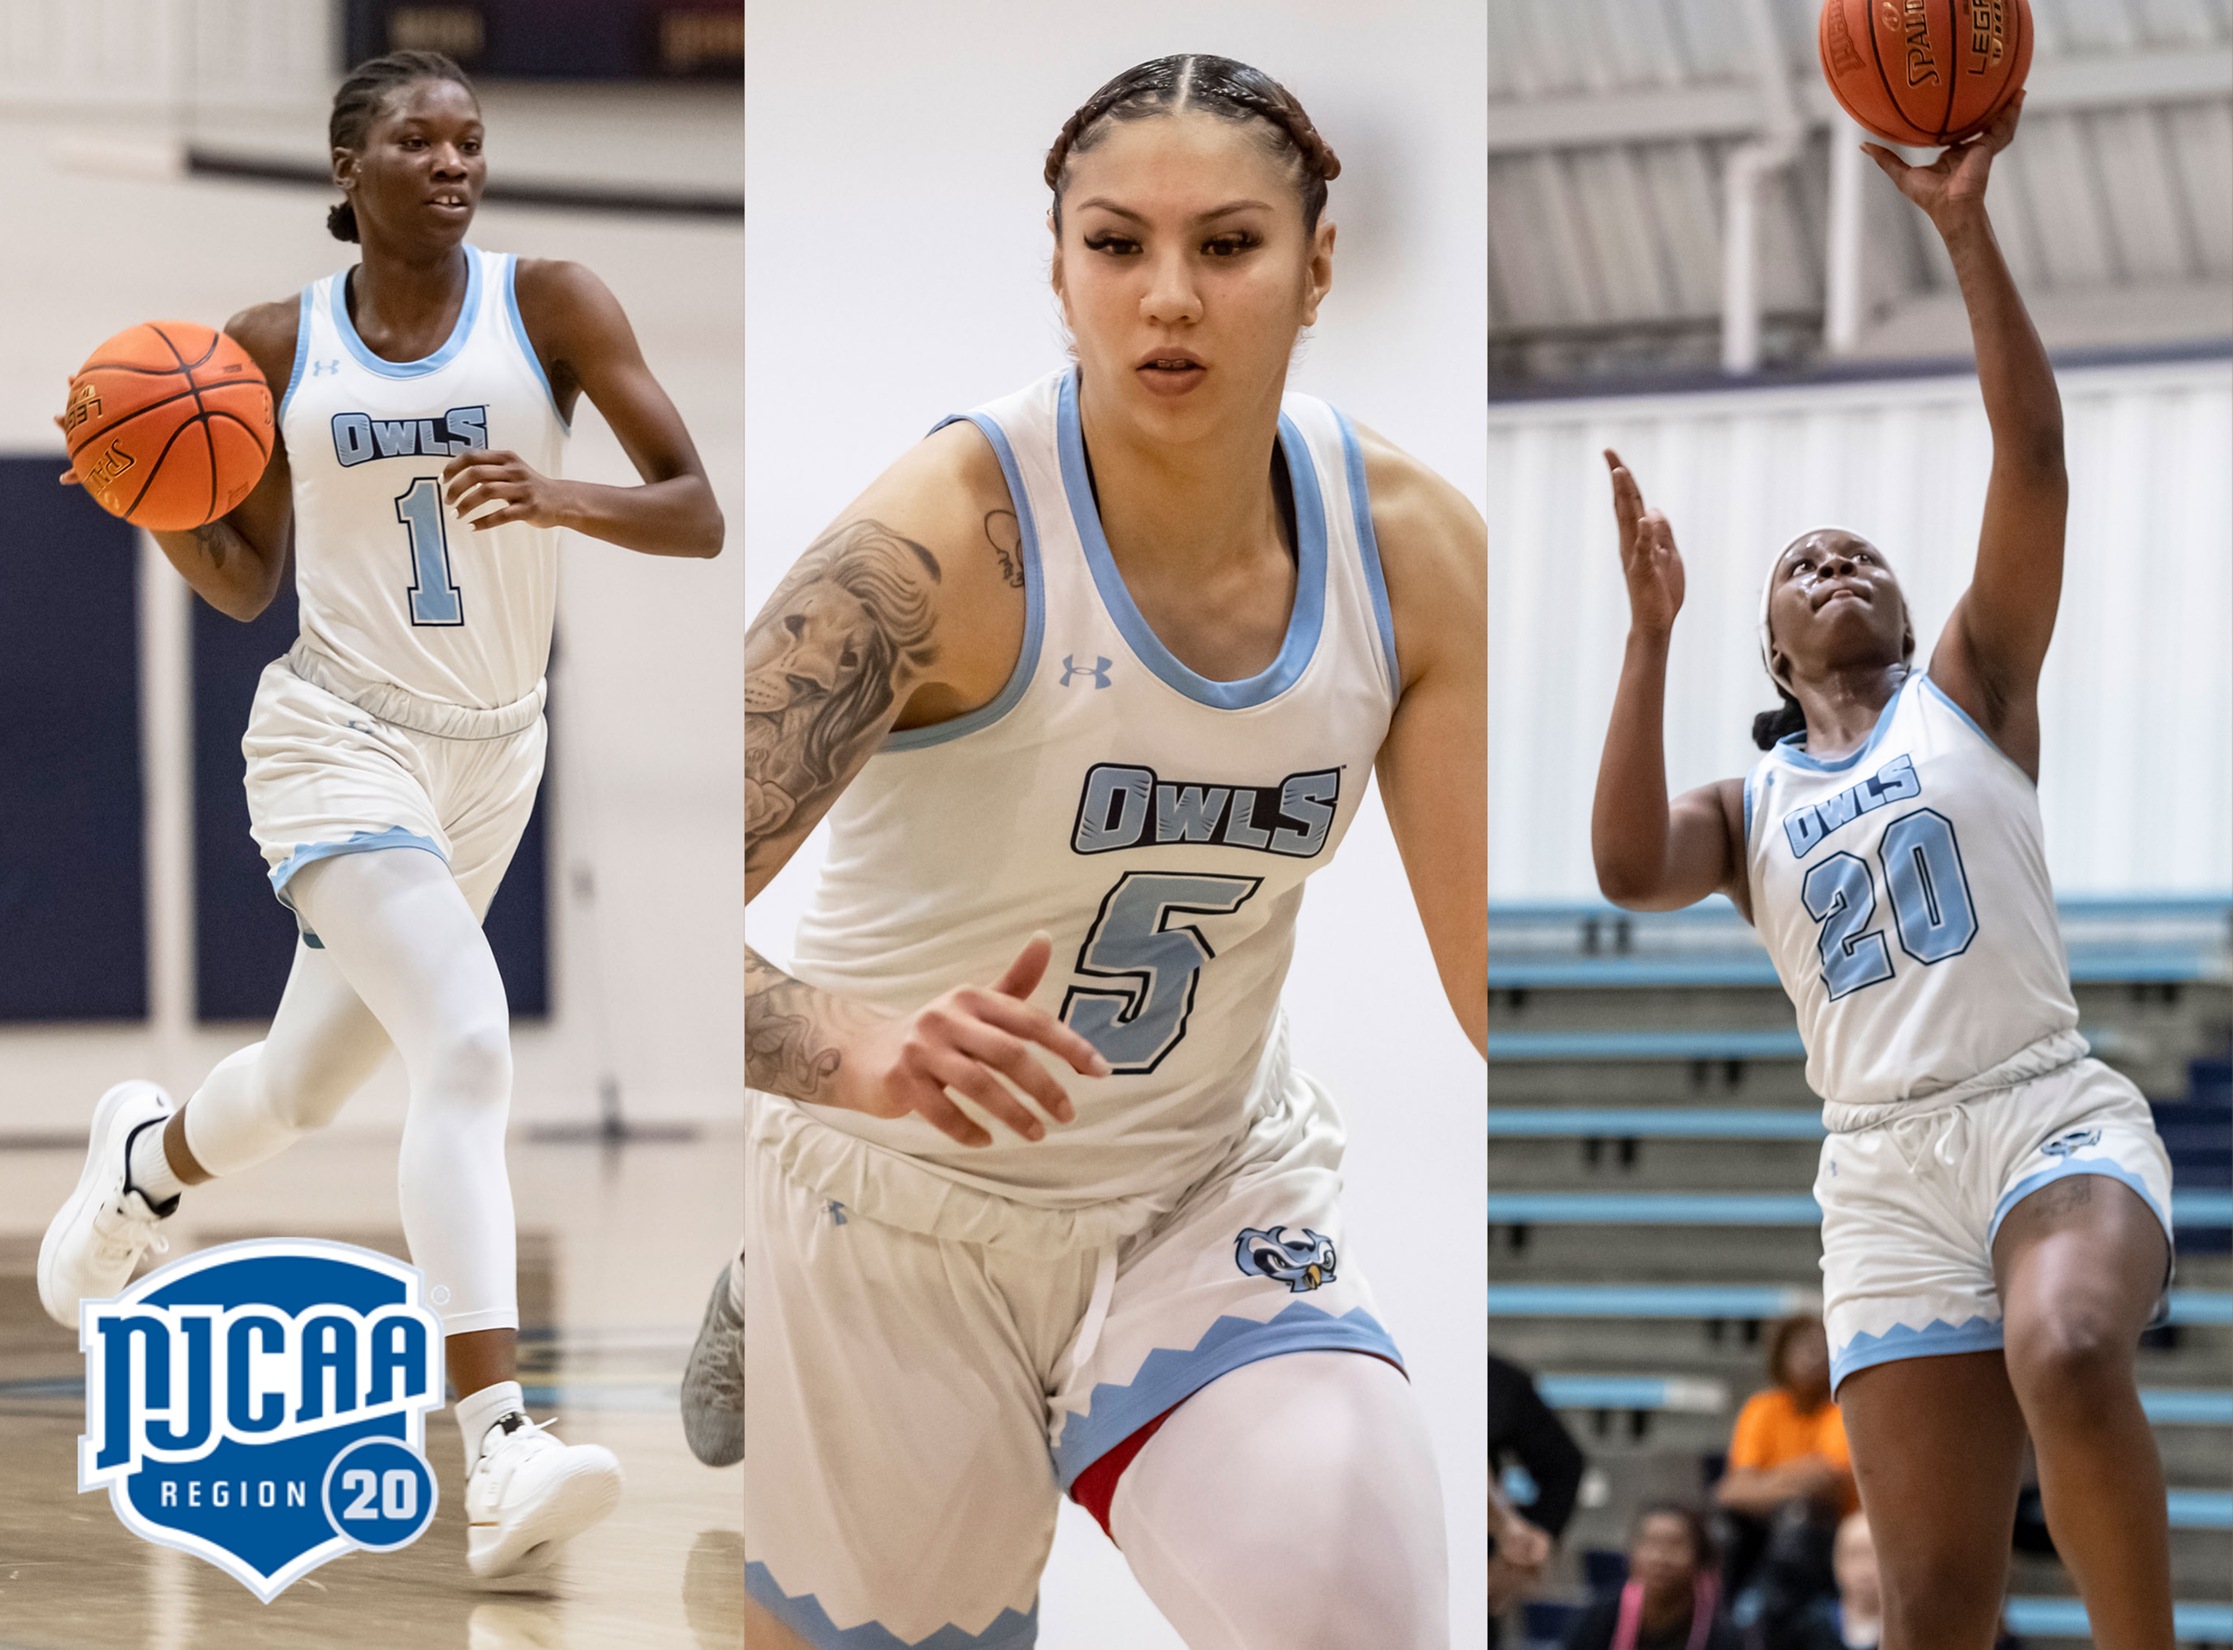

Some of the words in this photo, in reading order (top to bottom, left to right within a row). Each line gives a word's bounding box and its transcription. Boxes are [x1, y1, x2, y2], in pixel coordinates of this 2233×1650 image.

[331, 404, 489, 468] OWLS
[394, 476, 464, 626] 1
[1070, 762, 1341, 859] OWLS
[1783, 753, 1922, 859] OWLS
[1801, 807, 1979, 1003] 20
[1058, 871, 1265, 1075] 5
